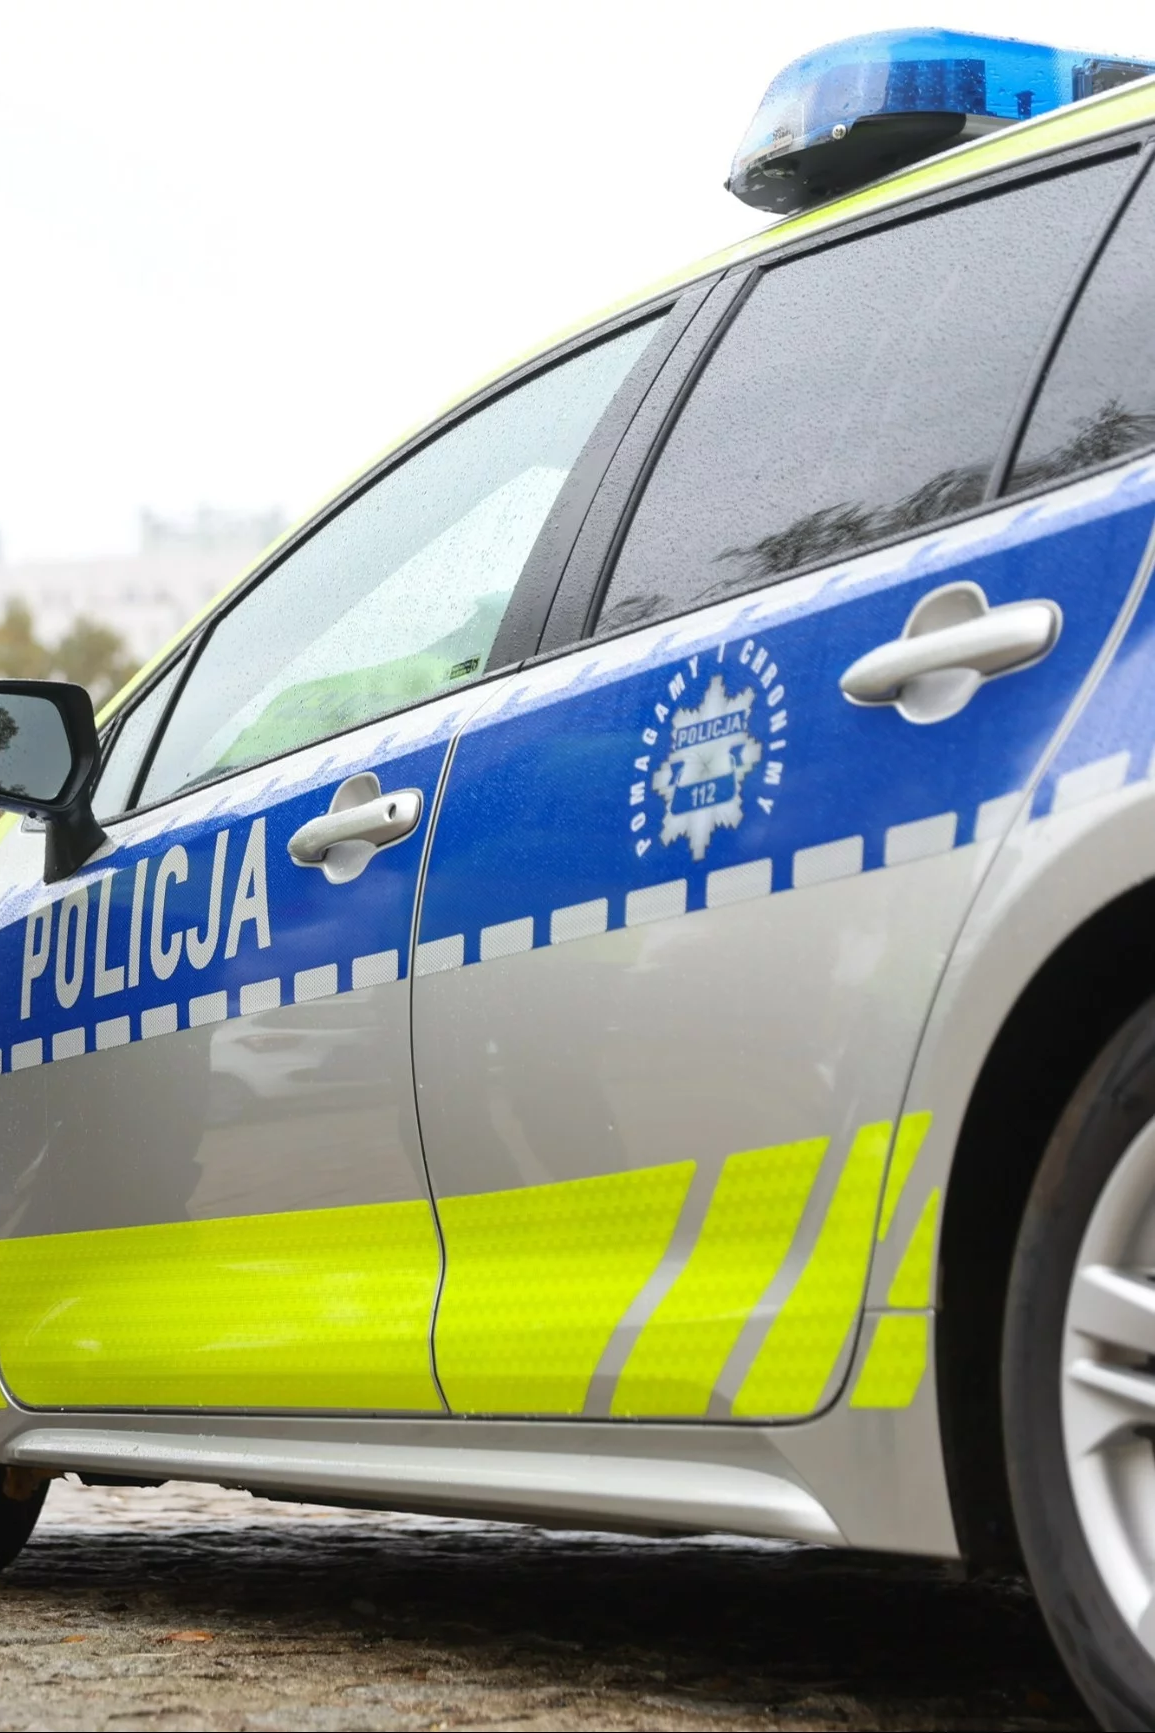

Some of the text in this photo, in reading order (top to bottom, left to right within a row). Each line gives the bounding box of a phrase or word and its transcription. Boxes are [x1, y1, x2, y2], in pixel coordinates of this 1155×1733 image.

[630, 655, 699, 857] POMAGAMY
[739, 639, 788, 815] CHRONIMY
[677, 714, 742, 748] POLICJA
[691, 783, 716, 807] 112
[20, 816, 272, 1020] POLICJA
